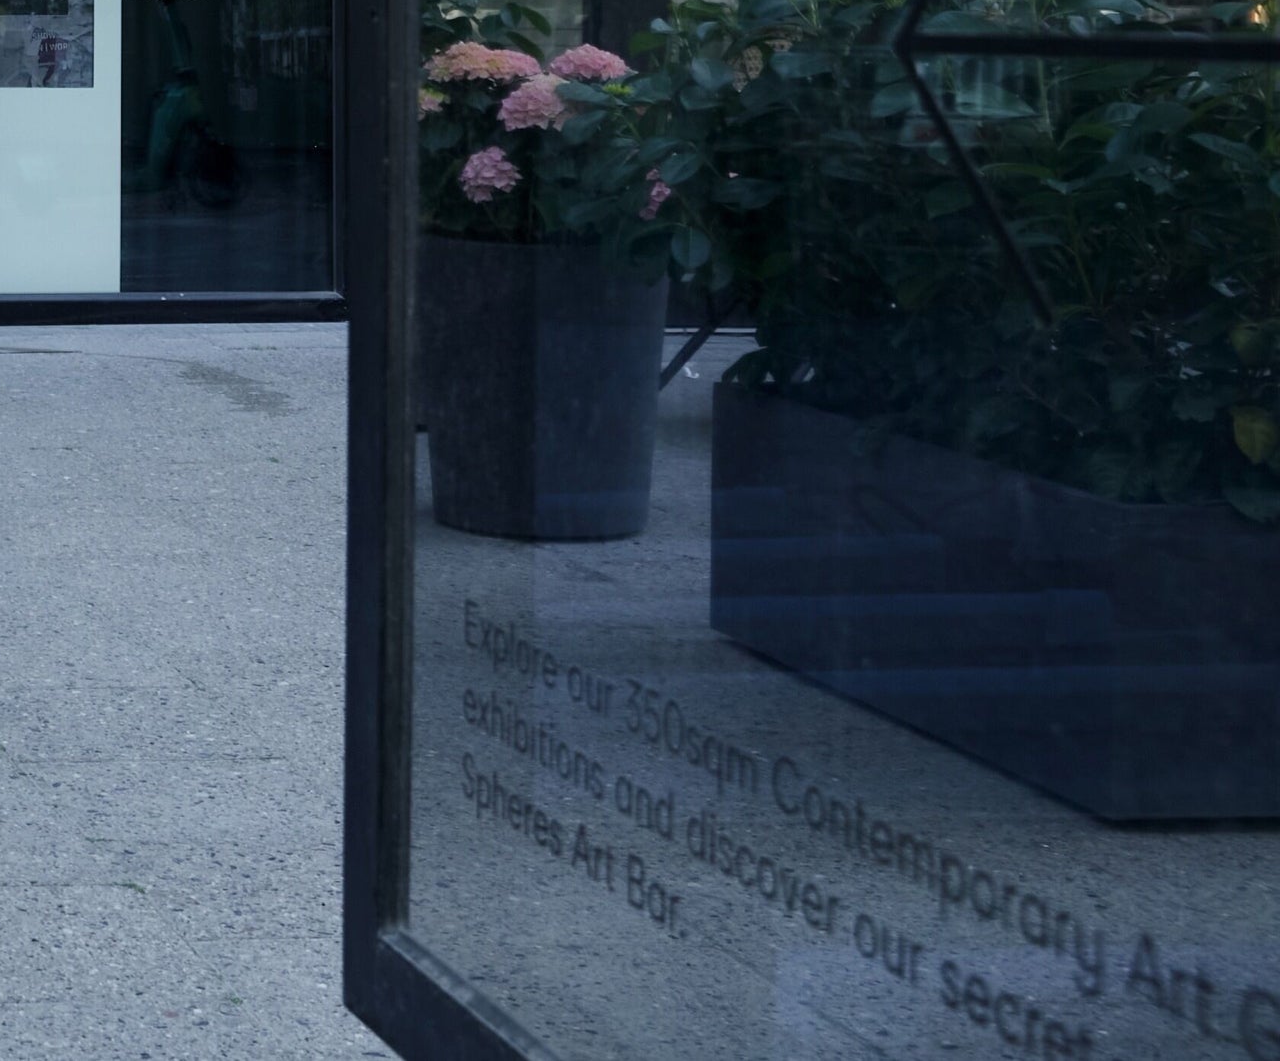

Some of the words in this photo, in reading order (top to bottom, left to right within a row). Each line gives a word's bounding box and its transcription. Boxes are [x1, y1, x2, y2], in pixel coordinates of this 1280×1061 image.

[460, 751, 563, 857] Spheres
[571, 822, 615, 893] Art
[462, 688, 605, 801] exhibitions
[613, 775, 674, 840] and
[685, 808, 838, 936] discover
[853, 912, 924, 986] our
[463, 598, 558, 688] Explore
[567, 665, 614, 718] our
[625, 678, 758, 800] 350sqm
[771, 755, 1105, 998] Contemporary
[1125, 932, 1218, 1040] Art
